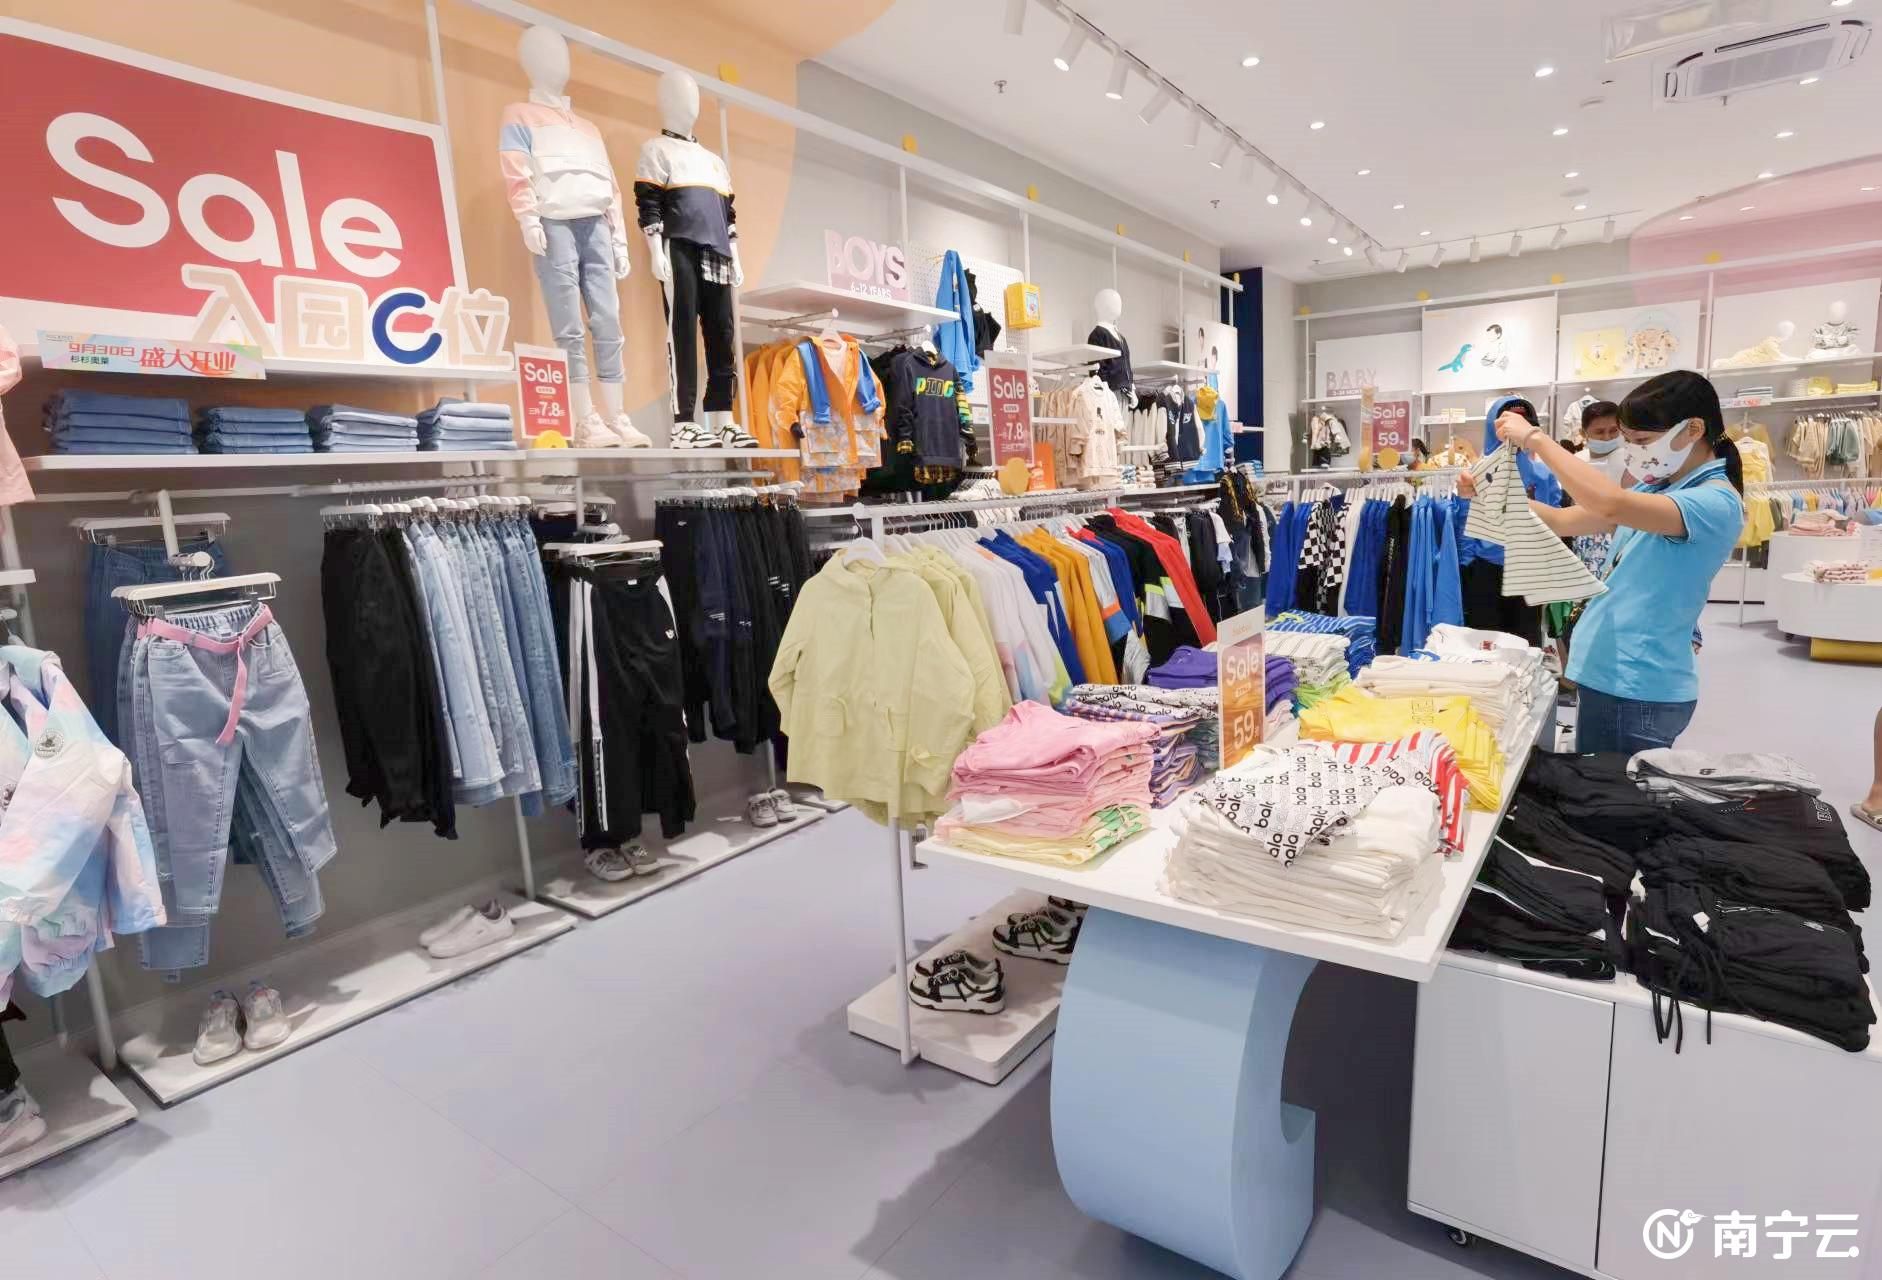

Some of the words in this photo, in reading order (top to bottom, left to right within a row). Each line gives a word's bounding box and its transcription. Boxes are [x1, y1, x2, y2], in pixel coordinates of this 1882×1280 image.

[45, 111, 404, 279] Sale
[185, 266, 511, 370] 入园C位
[68, 342, 135, 357] 9月30日
[140, 346, 236, 376] 盛大开业
[523, 361, 564, 384] Sale
[993, 375, 1026, 399] Sale
[1373, 404, 1406, 419] Sale
[1226, 646, 1259, 687] Sale
[1233, 709, 1255, 749] 59
